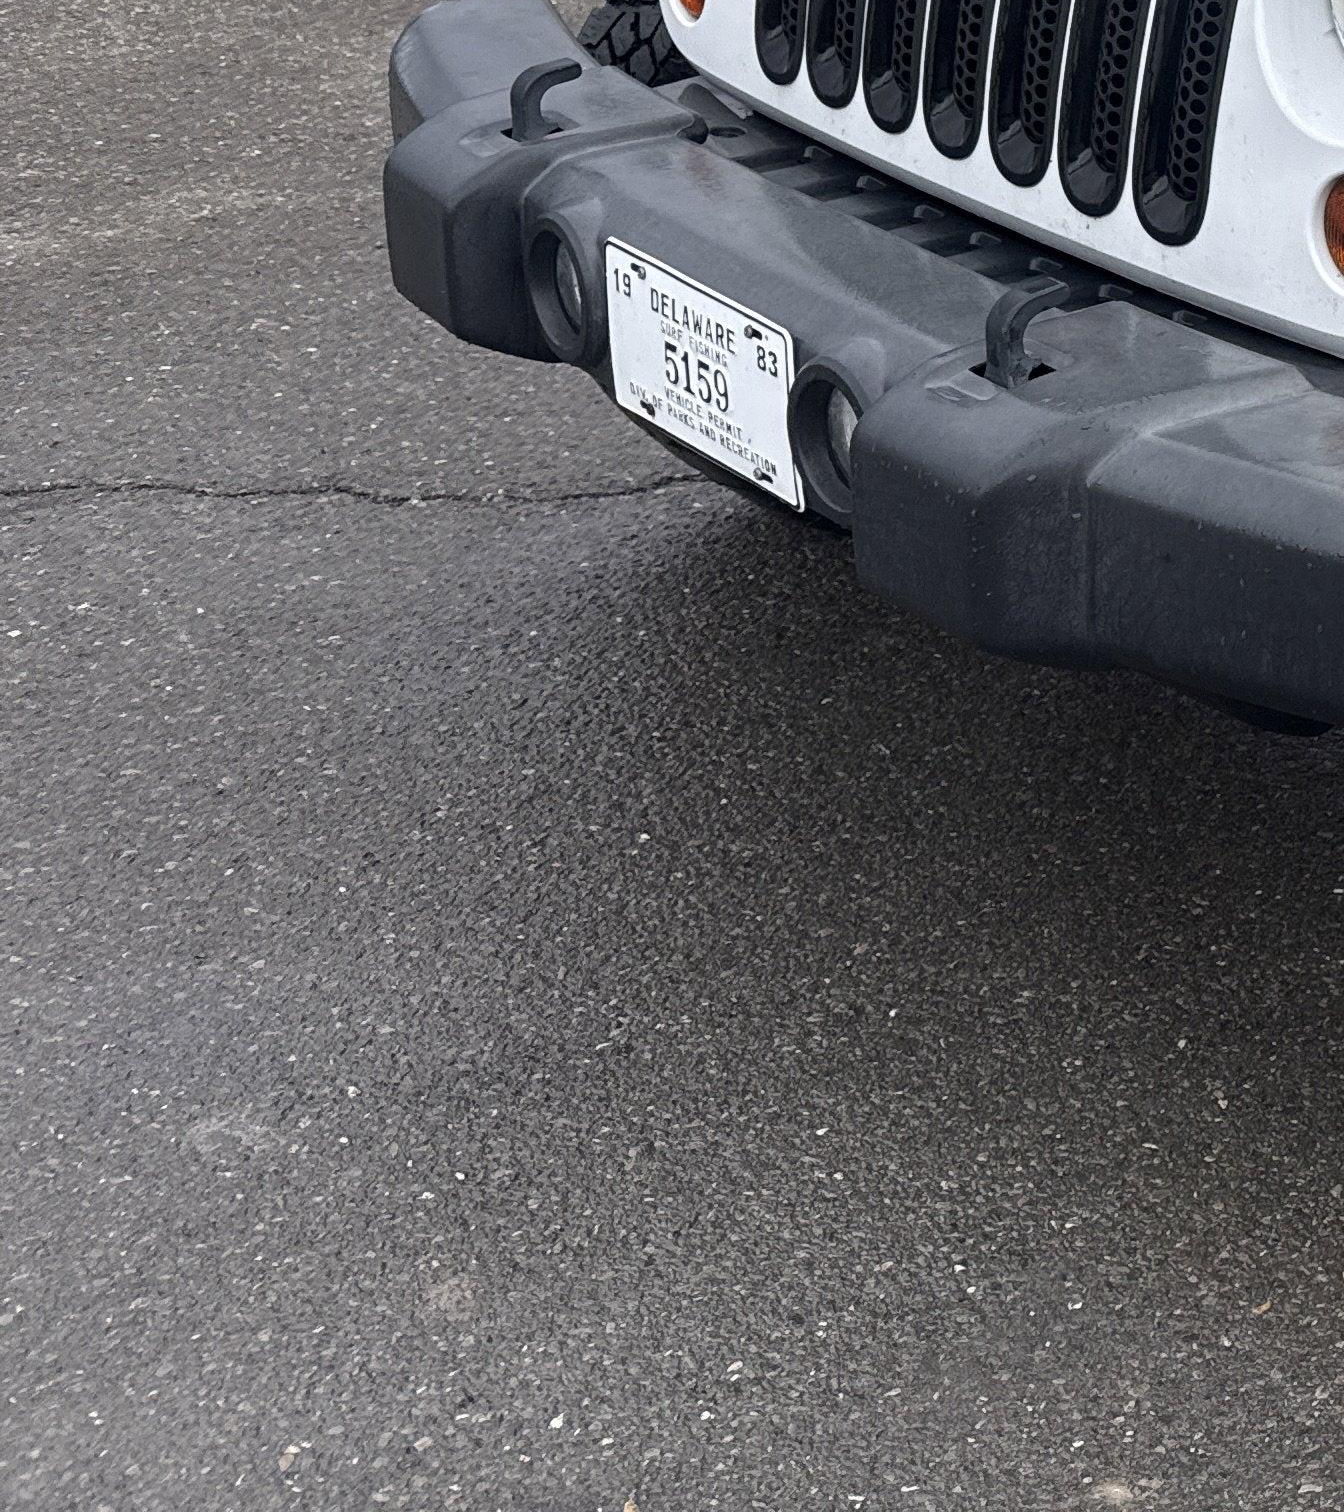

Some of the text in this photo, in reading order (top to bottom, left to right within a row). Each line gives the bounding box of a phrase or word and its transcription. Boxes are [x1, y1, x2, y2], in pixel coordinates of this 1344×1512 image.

[613, 268, 631, 298] 19
[650, 287, 736, 356] DELAWARE
[660, 320, 728, 368] SURF FISHING
[664, 341, 730, 413] 5159
[756, 345, 778, 378] 83
[653, 396, 663, 410] OF
[667, 403, 696, 430] PARKS
[699, 422, 717, 442] AND
[719, 433, 778, 476] RECREATION
[664, 385, 742, 440] VEHICLE PERMIT
